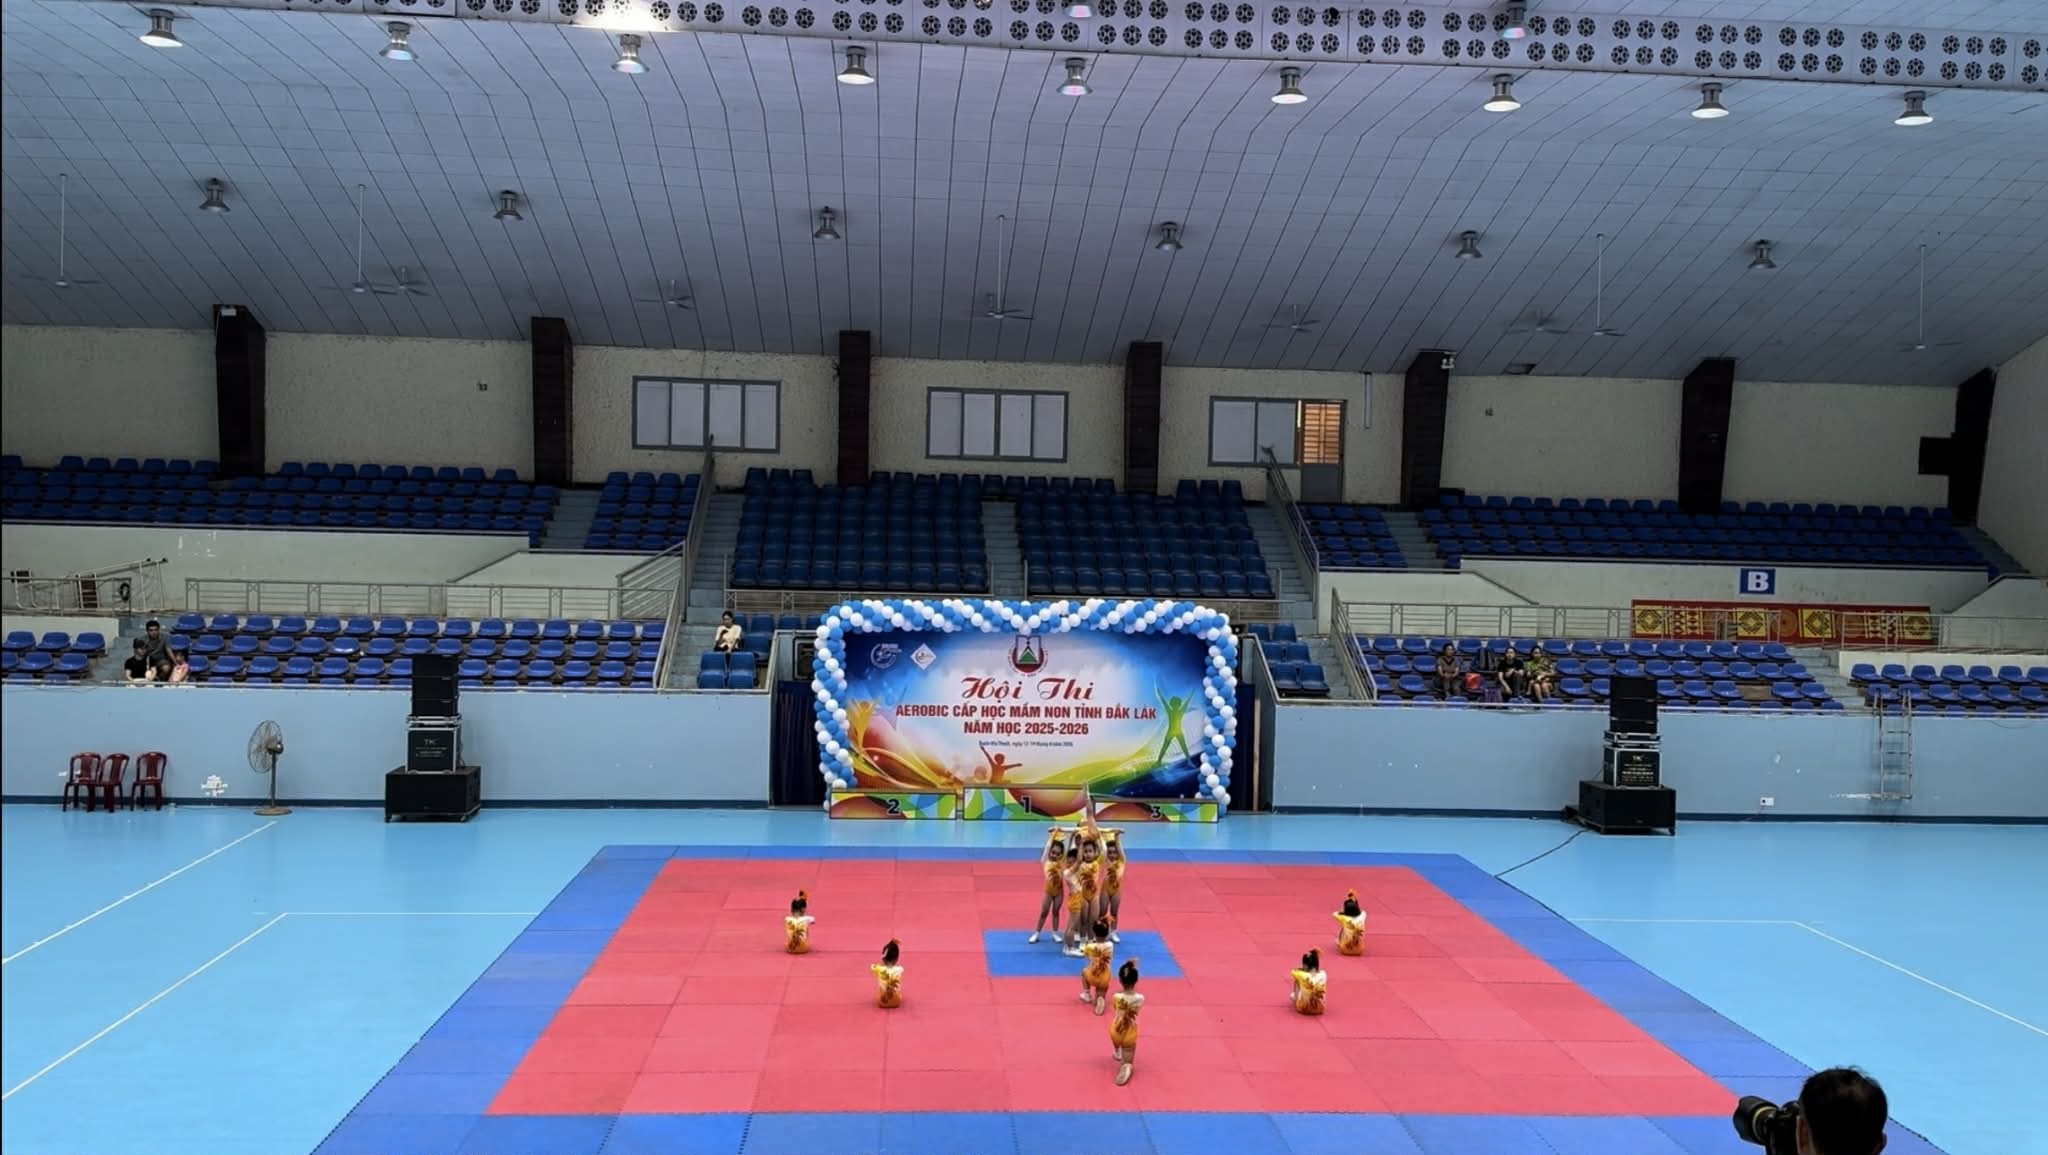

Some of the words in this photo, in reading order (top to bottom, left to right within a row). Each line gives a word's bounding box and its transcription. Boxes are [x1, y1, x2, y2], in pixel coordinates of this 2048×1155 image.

[1747, 571, 1769, 591] B
[961, 677, 1023, 703] Hội
[1037, 677, 1095, 700] Thi
[896, 704, 949, 717] AEROBIC
[953, 701, 977, 717] CẤP
[981, 705, 1006, 720] HỌC
[1044, 706, 1070, 718] NON
[964, 719, 993, 734] NĂM
[997, 722, 1021, 736] HỌC
[1025, 722, 1089, 735] 2025-2026
[887, 799, 900, 814] 2
[1021, 797, 1031, 813] 1
[1151, 805, 1161, 819] 3
